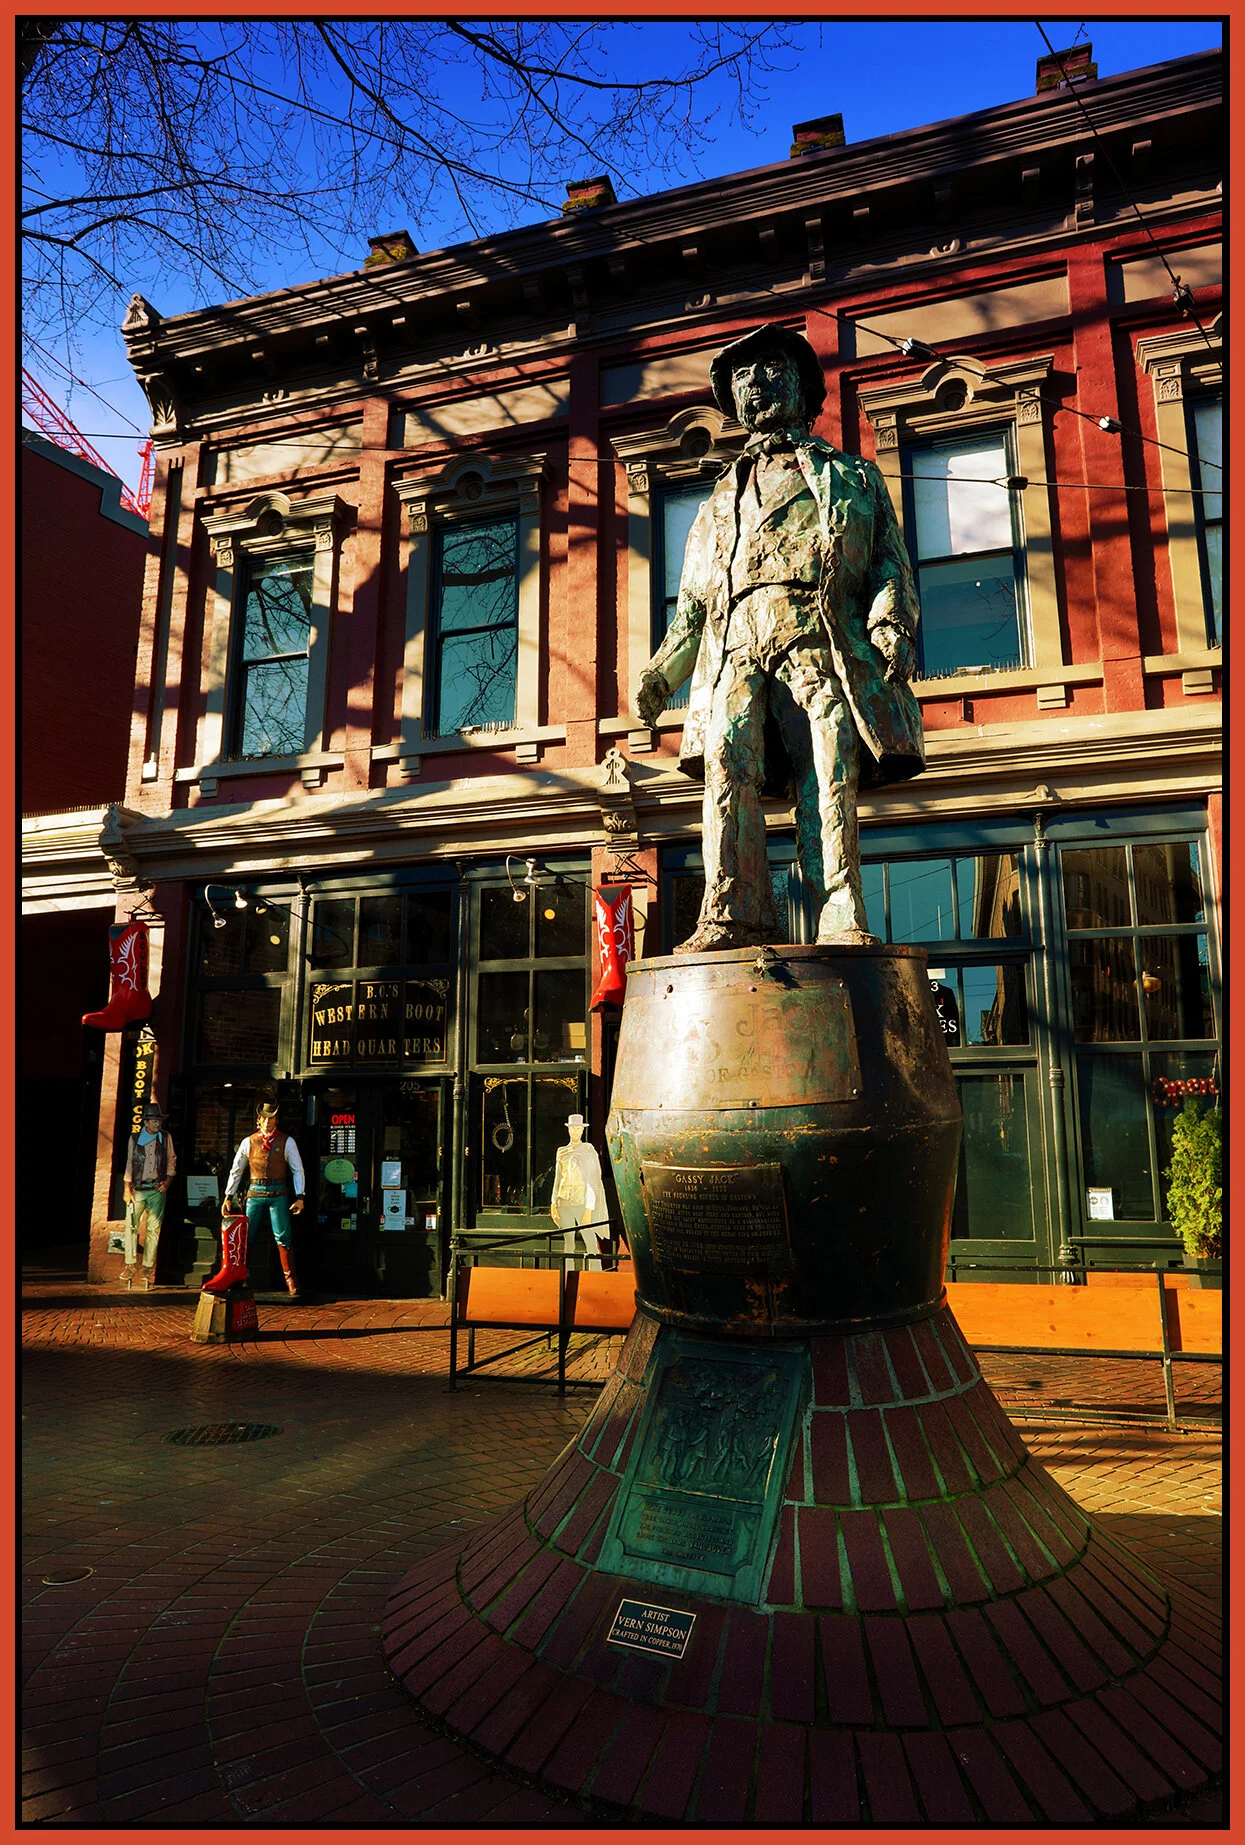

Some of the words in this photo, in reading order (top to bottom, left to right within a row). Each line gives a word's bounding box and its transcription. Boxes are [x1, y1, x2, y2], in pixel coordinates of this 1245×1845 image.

[366, 984, 399, 999] B.C.'S
[314, 1003, 389, 1027] WESTERN
[405, 1003, 444, 1021] BOOT
[134, 1060, 147, 1099] BOOT
[331, 1114, 356, 1125] OPEN
[641, 1610, 670, 1622] ARTIST
[611, 1628, 639, 1640] CRAFTED
[639, 1634, 648, 1642] IN
[618, 1616, 645, 1630] VERN
[645, 1622, 687, 1640] SIMPSON
